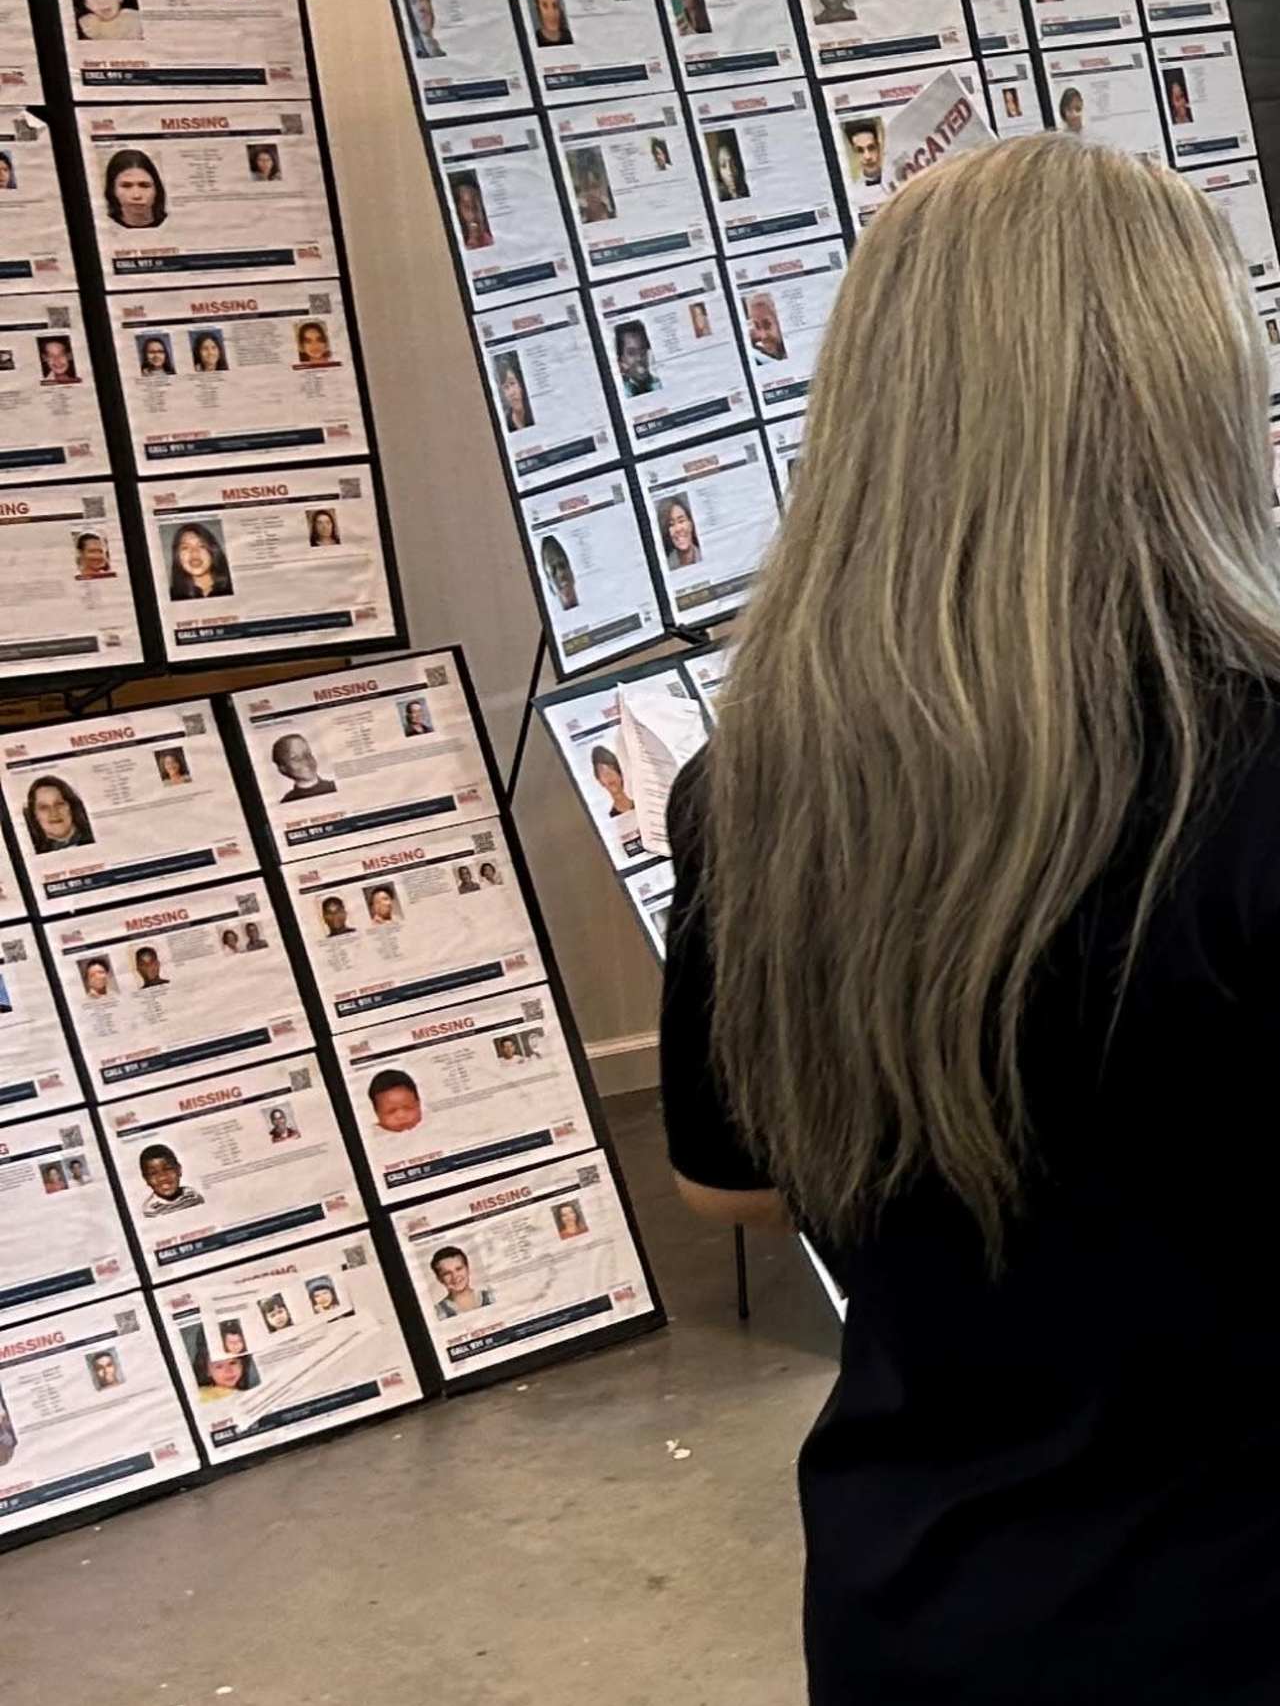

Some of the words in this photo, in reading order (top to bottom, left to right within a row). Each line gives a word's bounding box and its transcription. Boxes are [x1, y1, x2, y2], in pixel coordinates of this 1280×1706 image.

[161, 116, 229, 130] MISSING
[190, 299, 258, 315] MISSING
[221, 485, 289, 501] MISSING
[315, 680, 379, 701] MISSING
[71, 727, 135, 748] MISSING
[364, 848, 426, 871] MISSING
[125, 909, 189, 931] MISSING
[412, 1017, 475, 1039] MISSING
[180, 1086, 242, 1112] MISSING
[470, 1186, 532, 1213] MISSING
